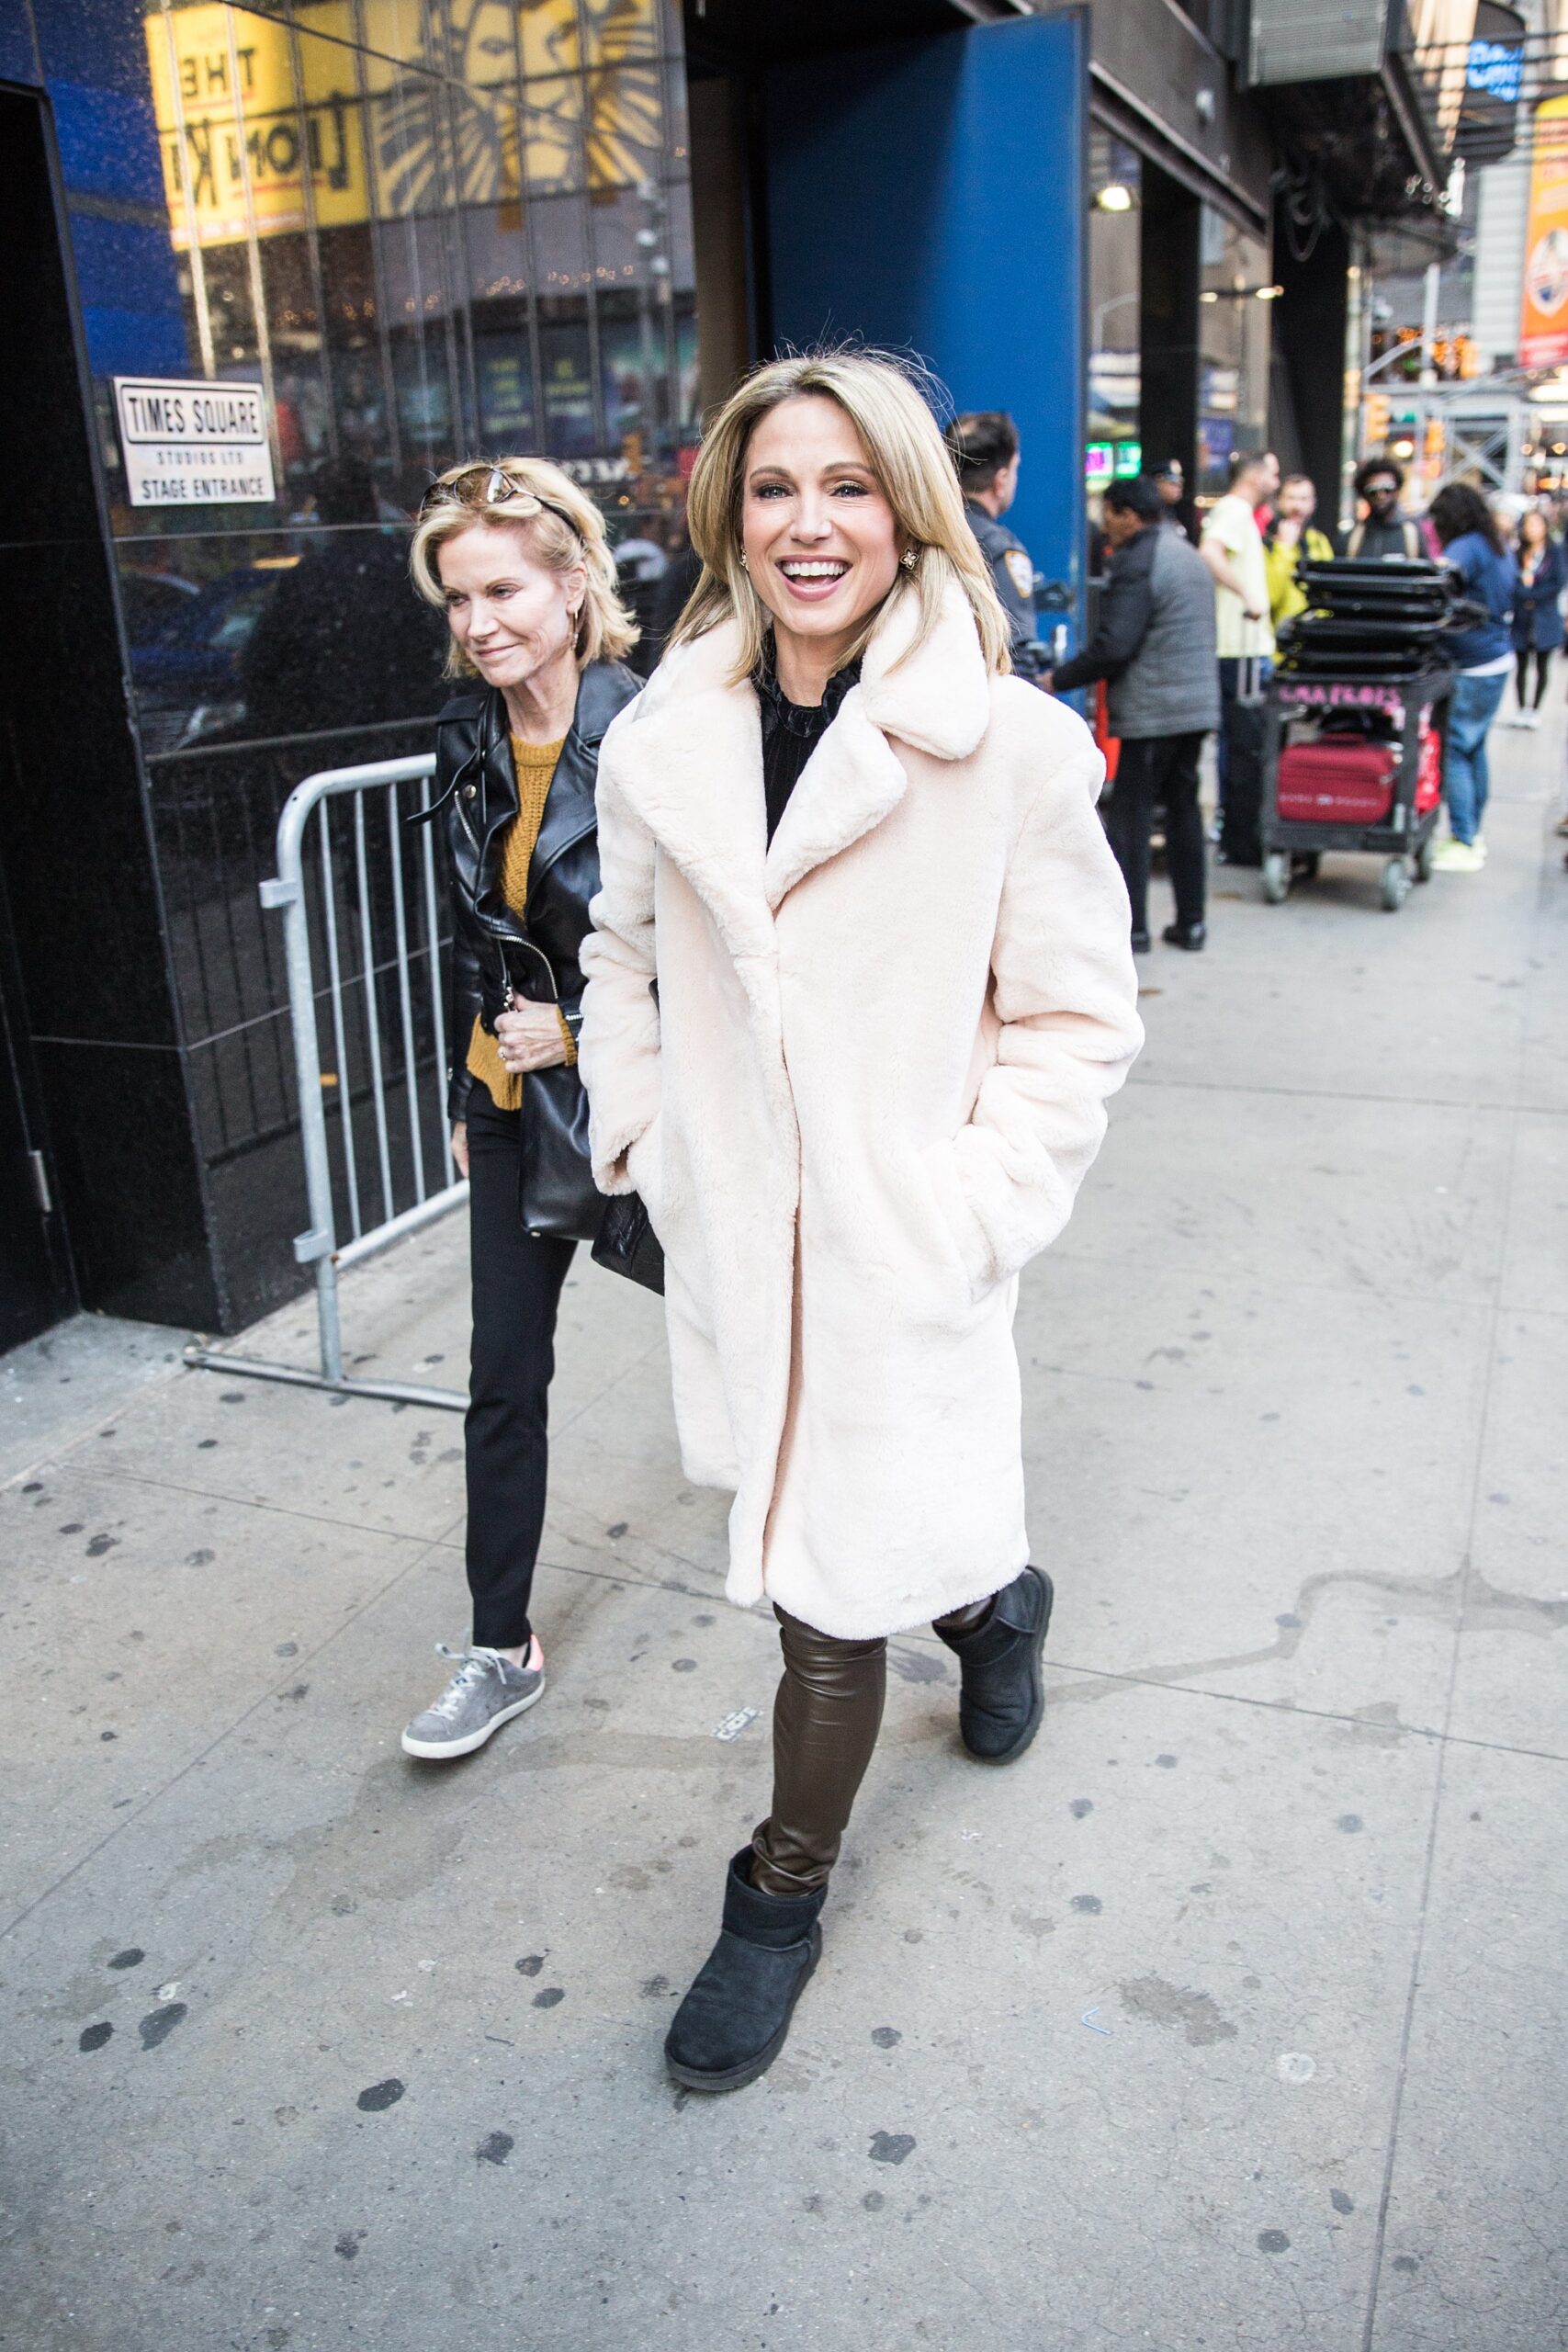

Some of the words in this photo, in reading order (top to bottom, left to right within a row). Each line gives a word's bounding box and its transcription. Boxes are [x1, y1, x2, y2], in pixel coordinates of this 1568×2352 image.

[129, 397, 186, 433] TIMES
[192, 399, 259, 435] SQUARE
[157, 450, 216, 466] STUDIOS
[141, 479, 187, 500] STAGE
[193, 477, 265, 499] ENTRANCE
